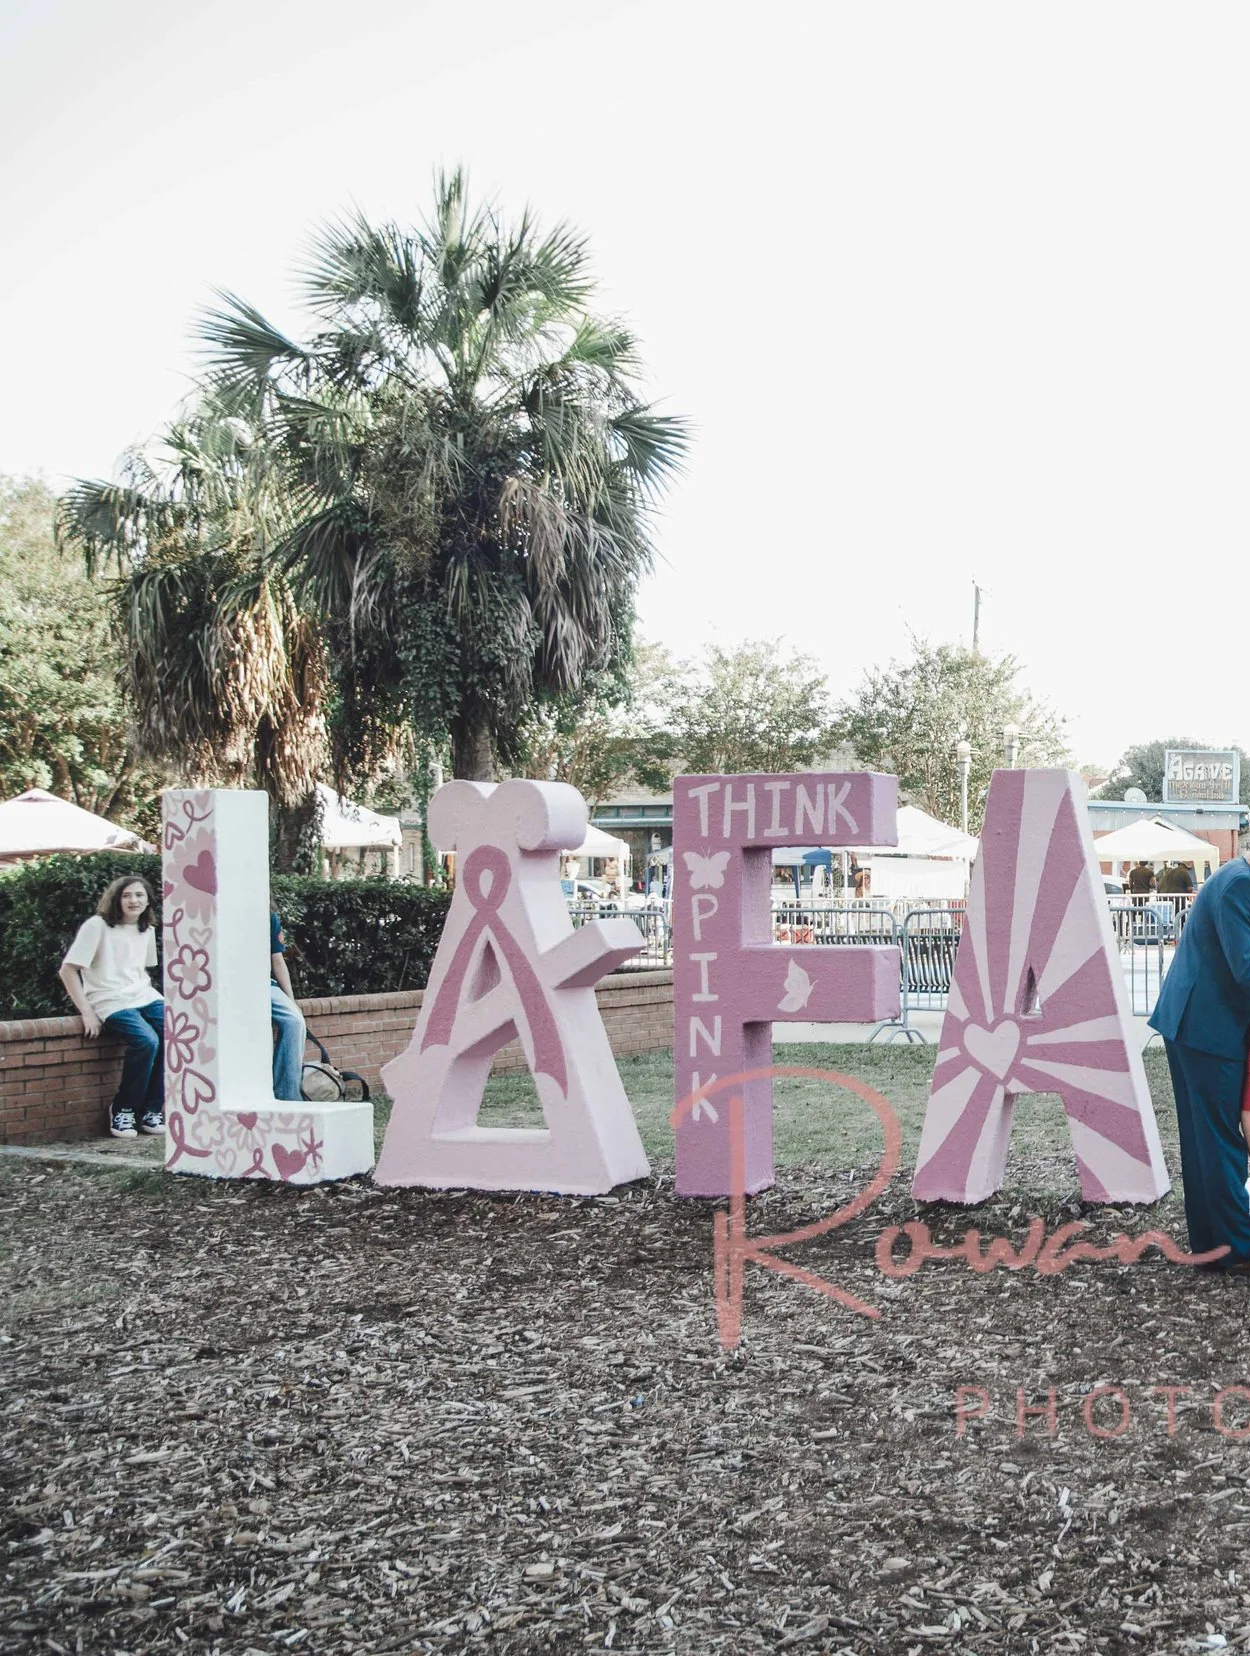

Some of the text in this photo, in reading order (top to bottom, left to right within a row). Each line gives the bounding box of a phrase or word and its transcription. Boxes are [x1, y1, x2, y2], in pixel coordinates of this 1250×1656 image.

[1168, 754, 1233, 781] AGAVE
[688, 780, 860, 840] THINK
[687, 893, 725, 1125] PINK
